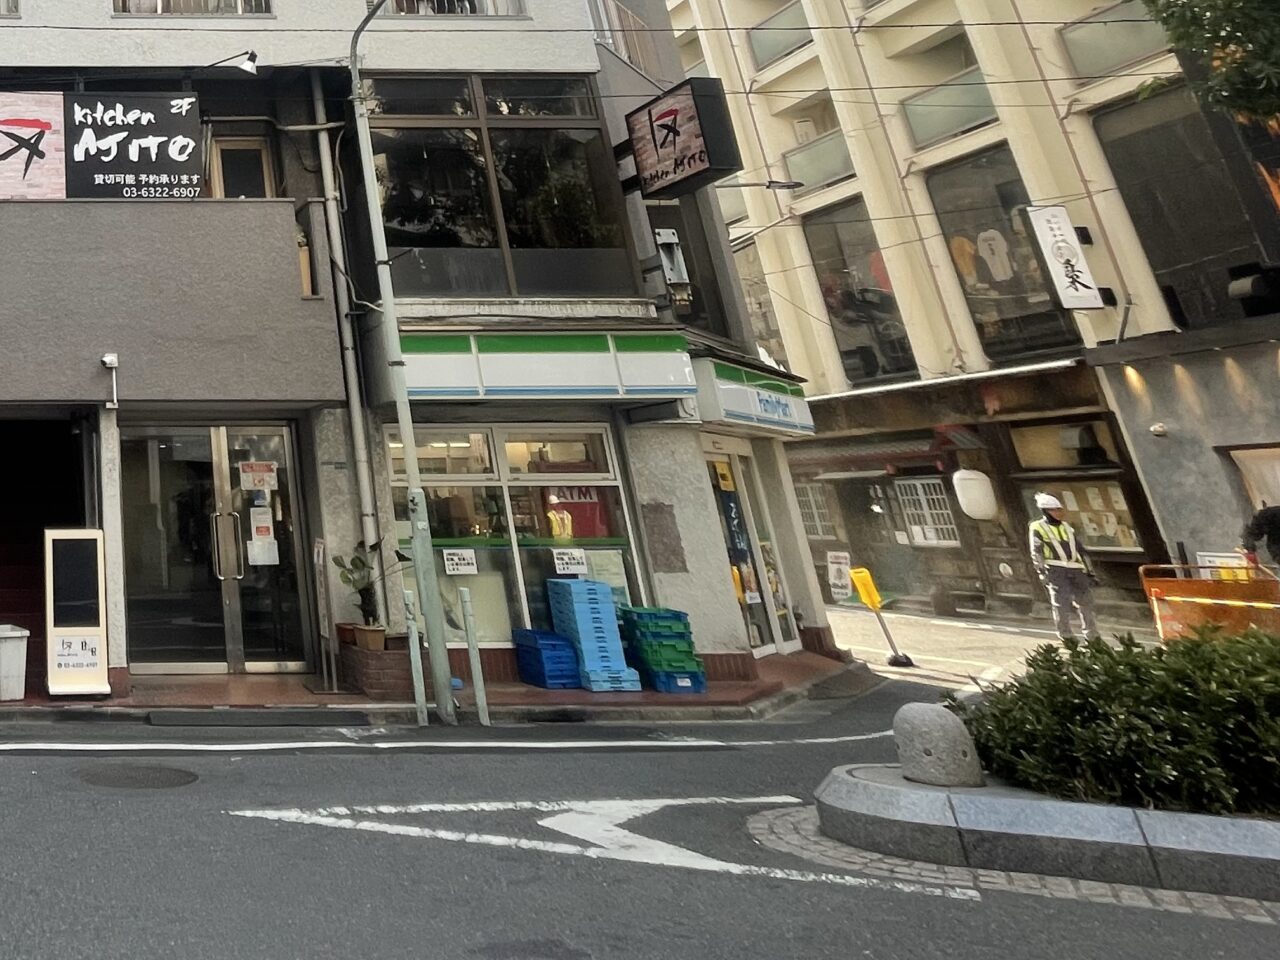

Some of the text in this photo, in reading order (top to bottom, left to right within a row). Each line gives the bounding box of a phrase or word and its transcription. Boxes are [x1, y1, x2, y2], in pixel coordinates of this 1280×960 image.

[93, 173, 201, 185] 貸切可能 予約承ります
[122, 187, 201, 198] 03-6322-6907
